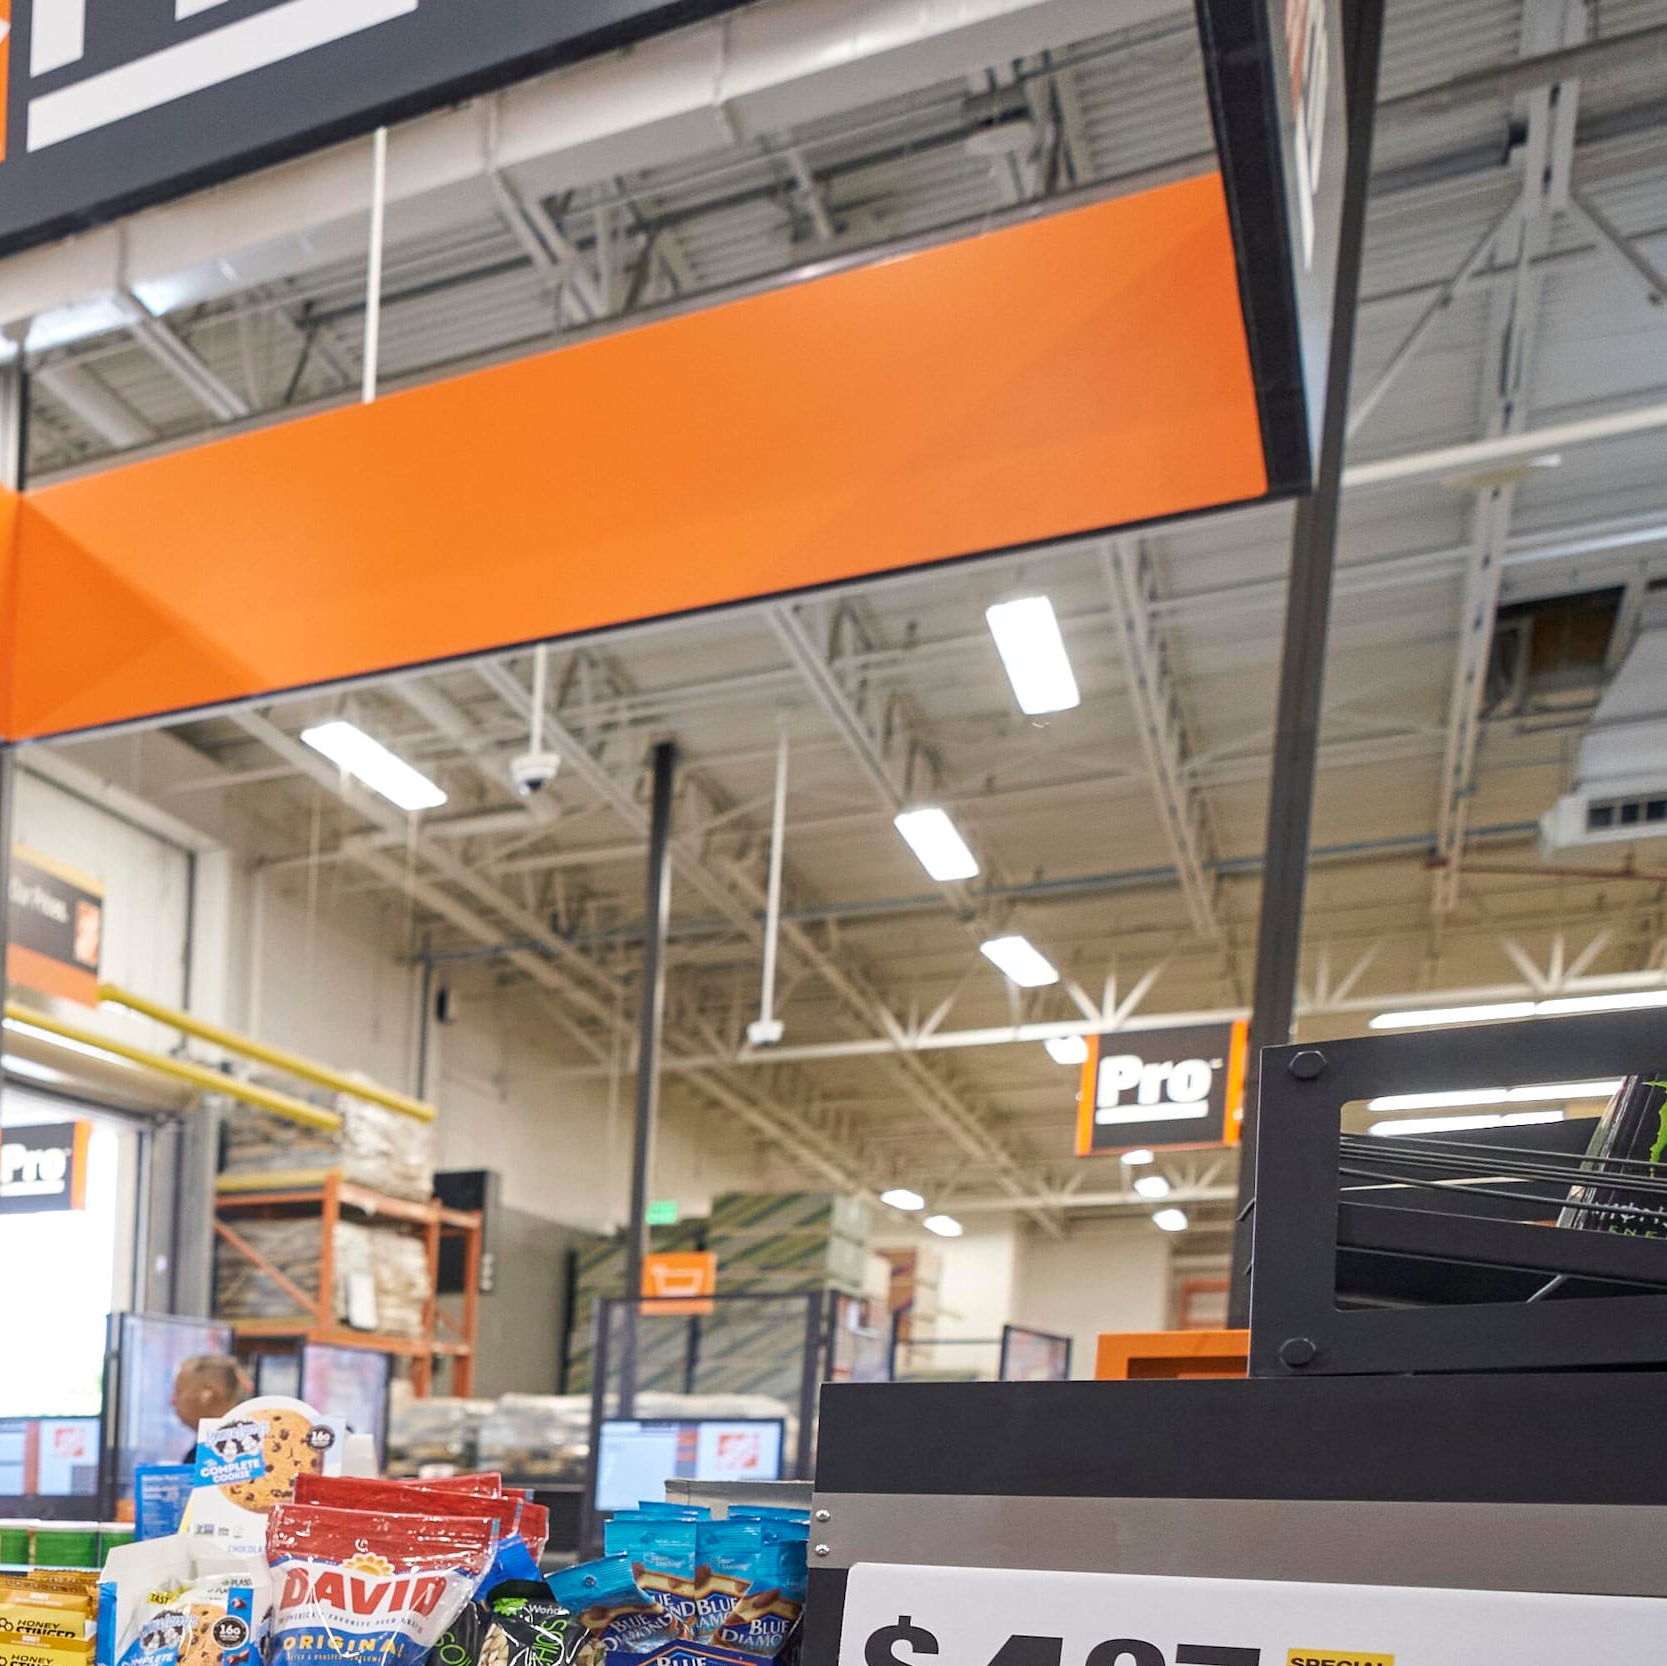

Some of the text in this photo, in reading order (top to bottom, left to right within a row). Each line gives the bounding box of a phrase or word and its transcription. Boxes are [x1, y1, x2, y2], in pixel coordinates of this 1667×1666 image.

[200, 1457, 261, 1478] COMPLETE
[228, 1544, 264, 1554] CHOCOLA
[150, 1592, 170, 1605] TAST
[279, 1567, 447, 1617] DAVID
[17, 1618, 61, 1629] HONEY
[611, 1613, 651, 1633] BLUE
[721, 1628, 785, 1646] DIAMO
[11, 1653, 53, 1664] HONEY
